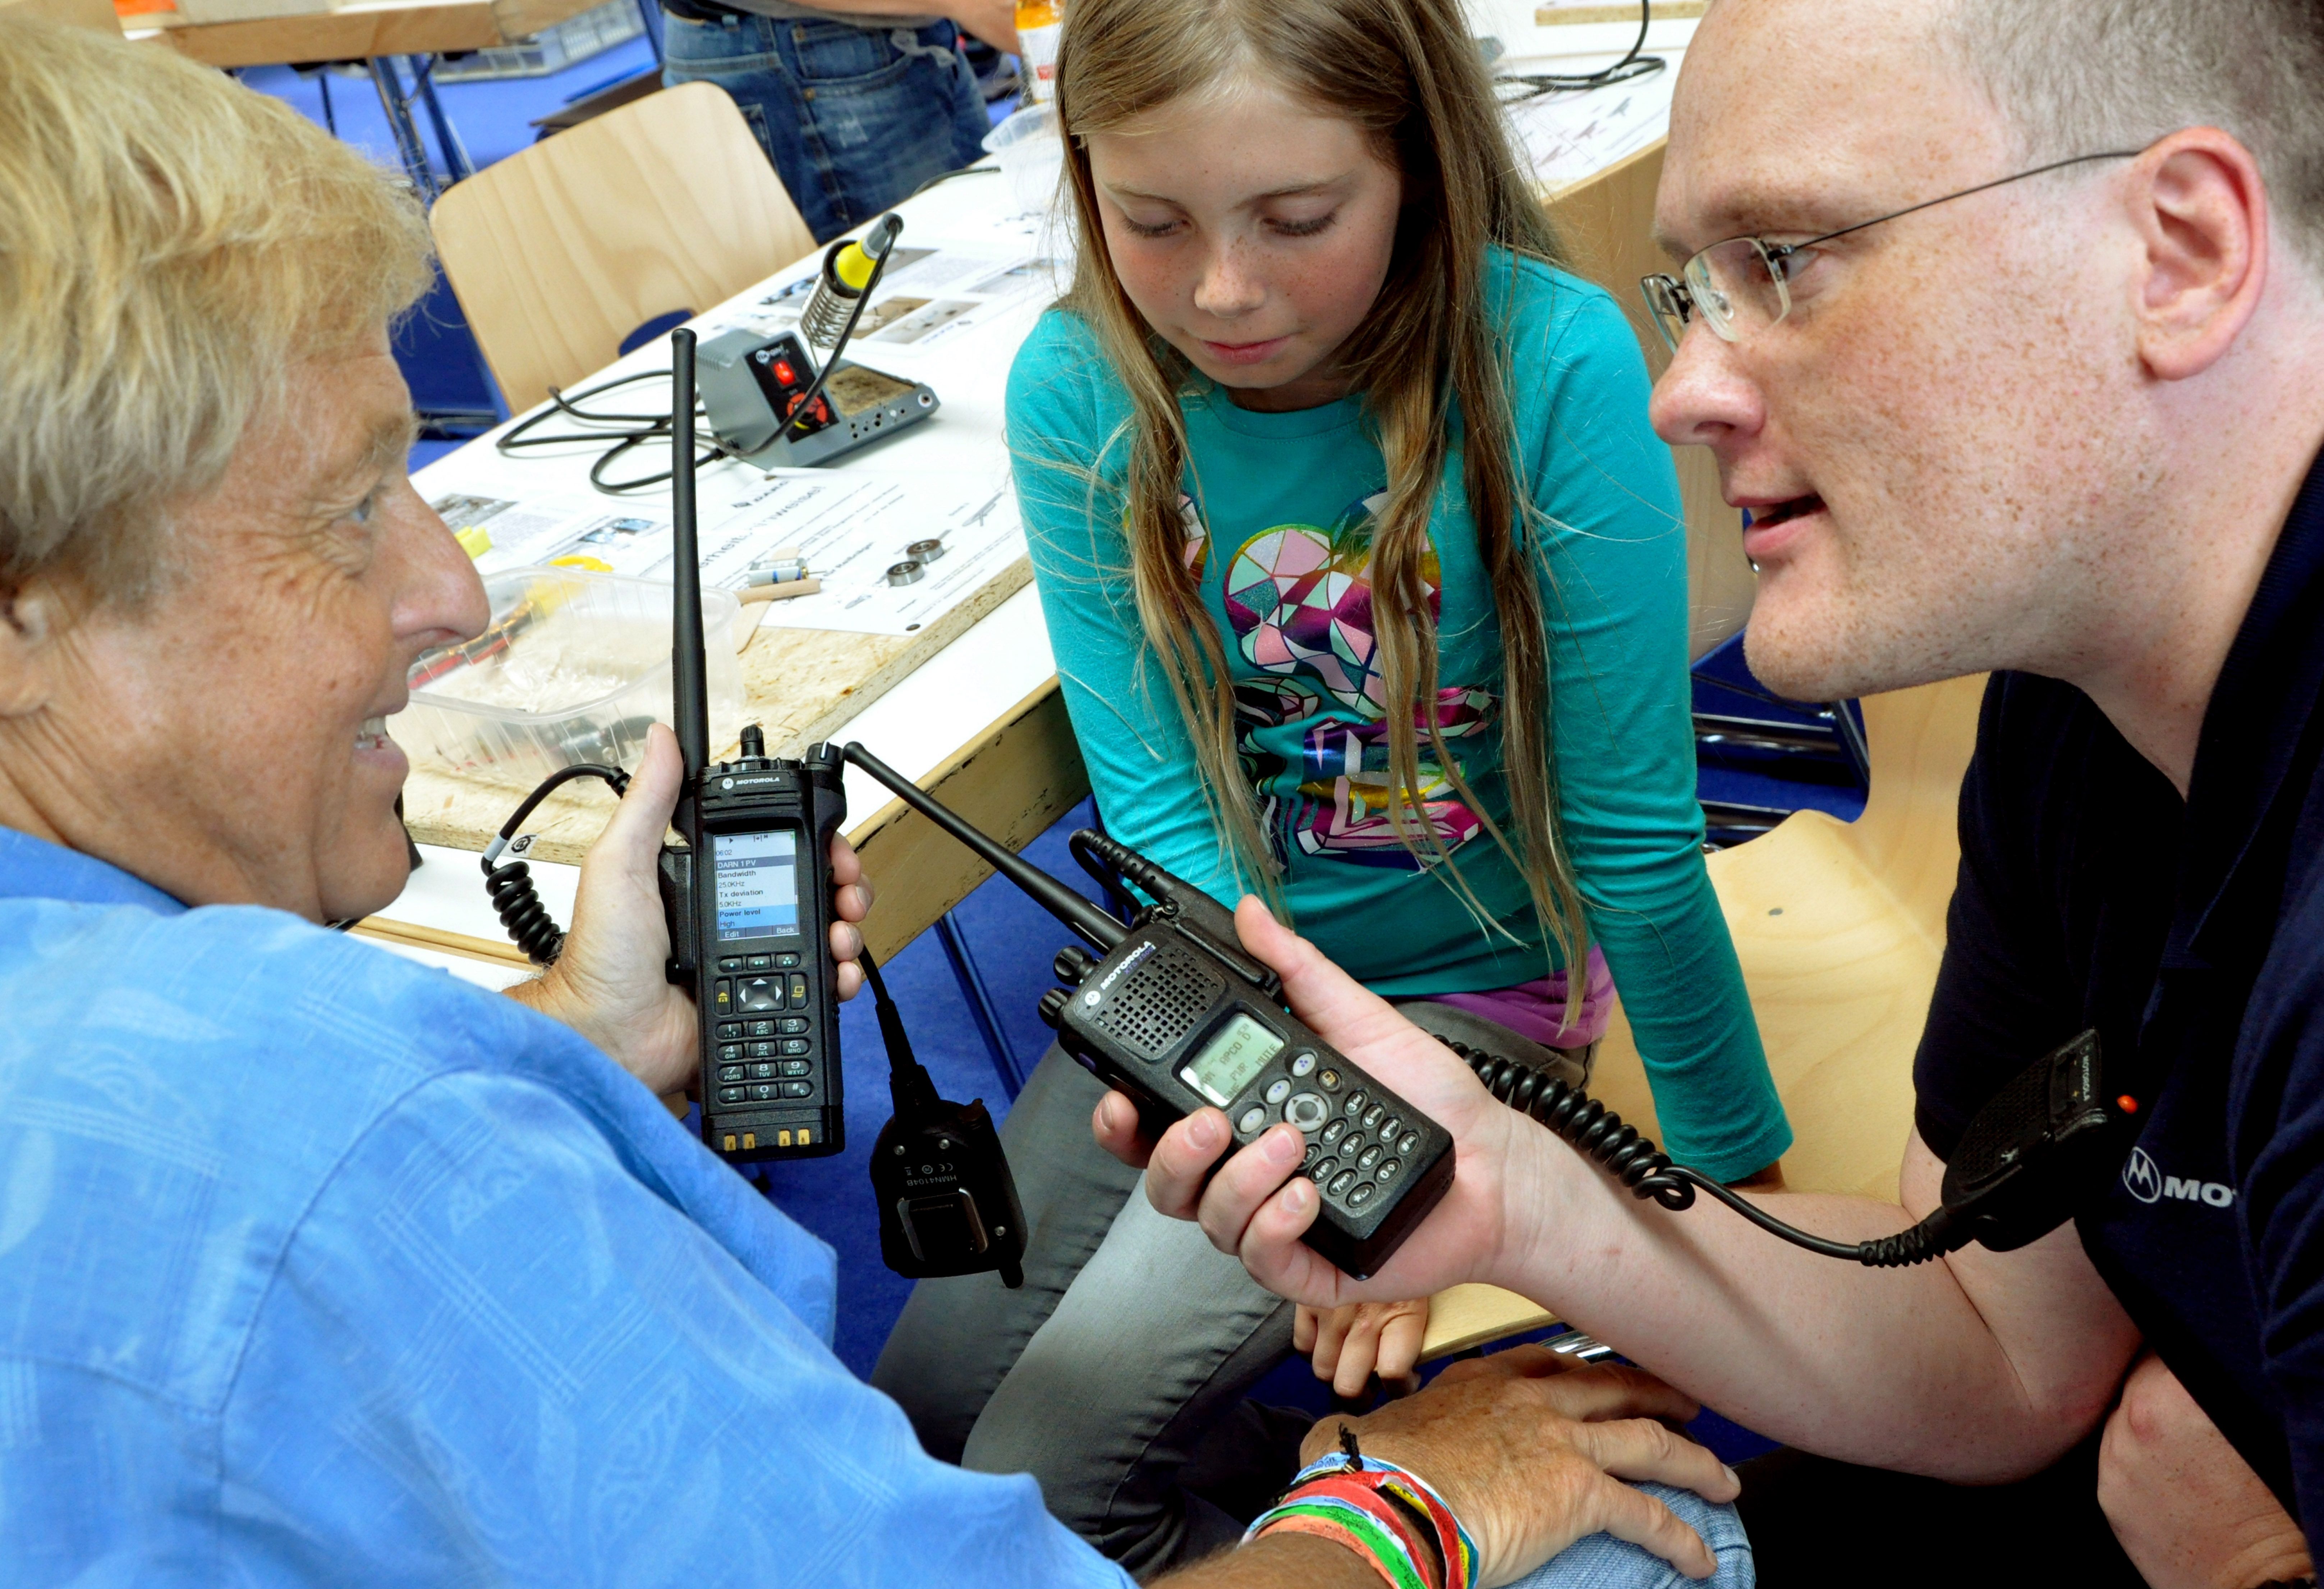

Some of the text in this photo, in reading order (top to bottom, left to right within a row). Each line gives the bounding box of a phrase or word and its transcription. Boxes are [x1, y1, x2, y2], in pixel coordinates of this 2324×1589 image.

[736, 777, 780, 785] MOTOROLA
[720, 921, 735, 929] High
[1100, 941, 1152, 990] MOTOROLA
[1124, 962, 1138, 975] XTS
[1255, 1043, 1278, 1067] MUTE
[906, 1174, 957, 1186] HMN4104B
[2163, 1175, 2238, 1208] MO
